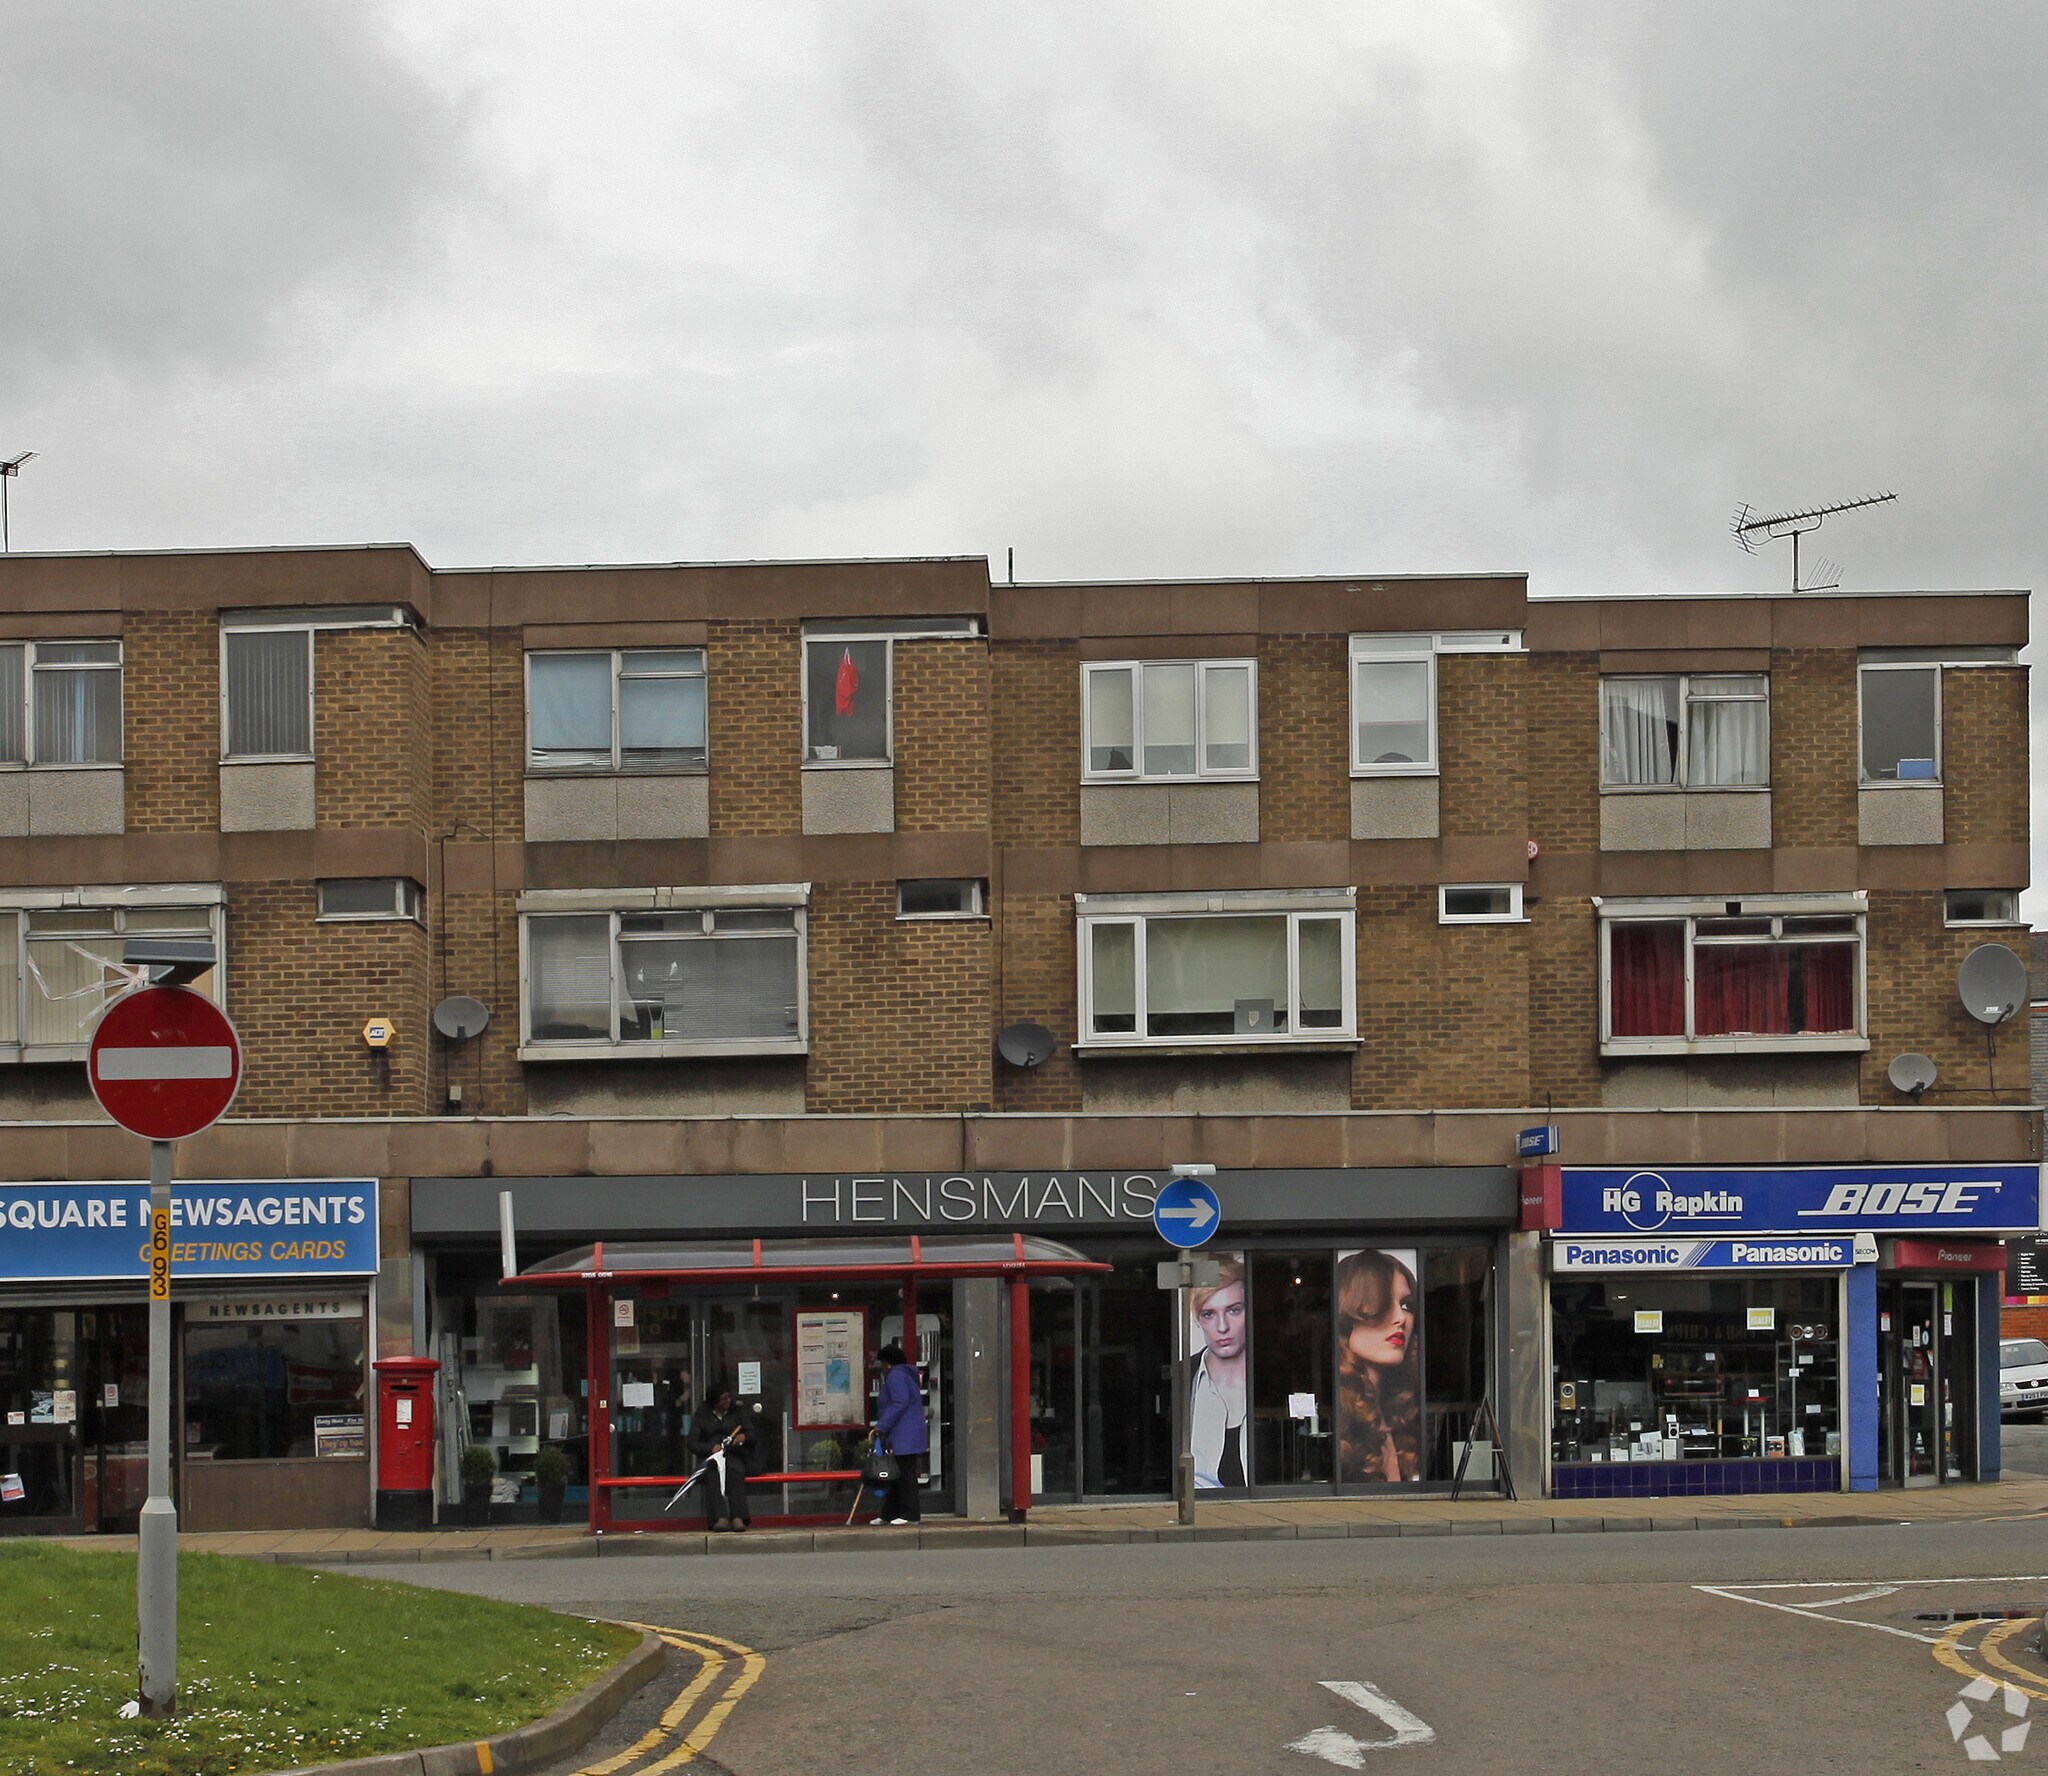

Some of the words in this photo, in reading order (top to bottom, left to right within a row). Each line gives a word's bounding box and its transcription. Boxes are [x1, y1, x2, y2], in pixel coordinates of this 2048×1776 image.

[802, 1175, 1157, 1222] HENSMANS
[1602, 1189, 1641, 1213] HG
[1655, 1190, 1743, 1217] Rapkin
[1797, 1181, 2002, 1216] BOSE
[138, 1242, 263, 1264] GEETINGS
[270, 1240, 347, 1261] CARDS
[1566, 1245, 1680, 1265] Panasonic
[1731, 1242, 1843, 1263] Panasonic
[1937, 1248, 1972, 1262] Pioneer
[208, 1302, 341, 1317] NEWSAGENTS
